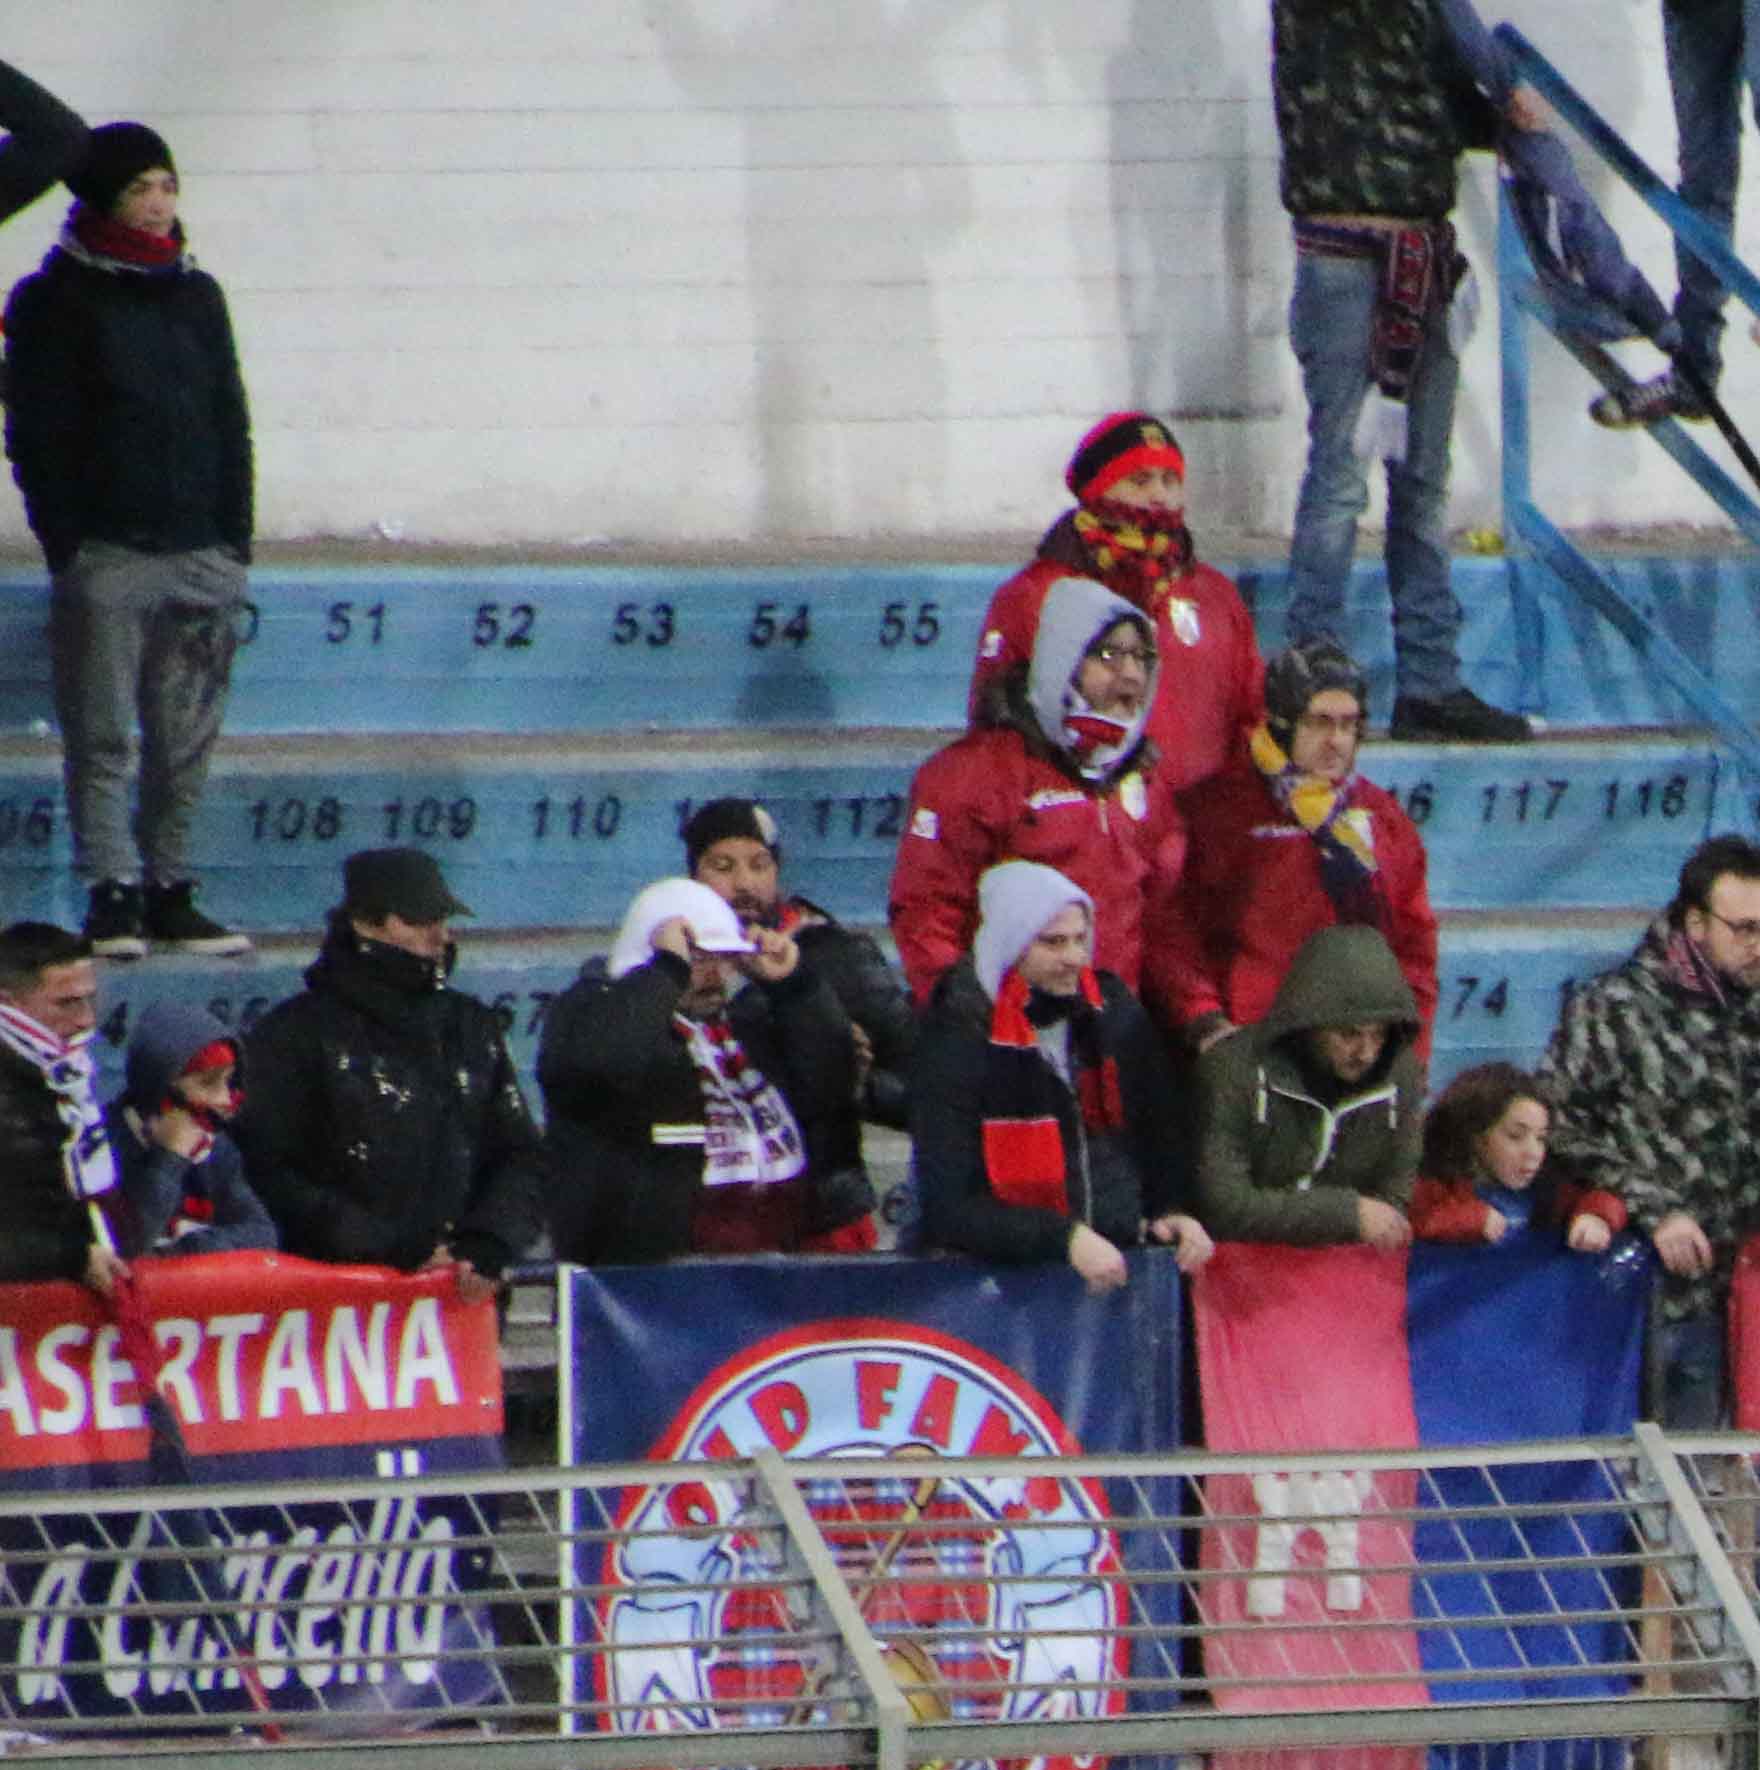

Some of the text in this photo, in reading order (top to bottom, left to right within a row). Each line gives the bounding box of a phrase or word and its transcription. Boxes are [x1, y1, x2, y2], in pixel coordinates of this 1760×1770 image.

[326, 601, 940, 648] 51 52 53 54 55
[248, 797, 343, 841] 108
[383, 796, 480, 841] 109
[531, 795, 622, 841] 110
[1481, 779, 1569, 822] 117
[1451, 976, 1509, 1022] 74
